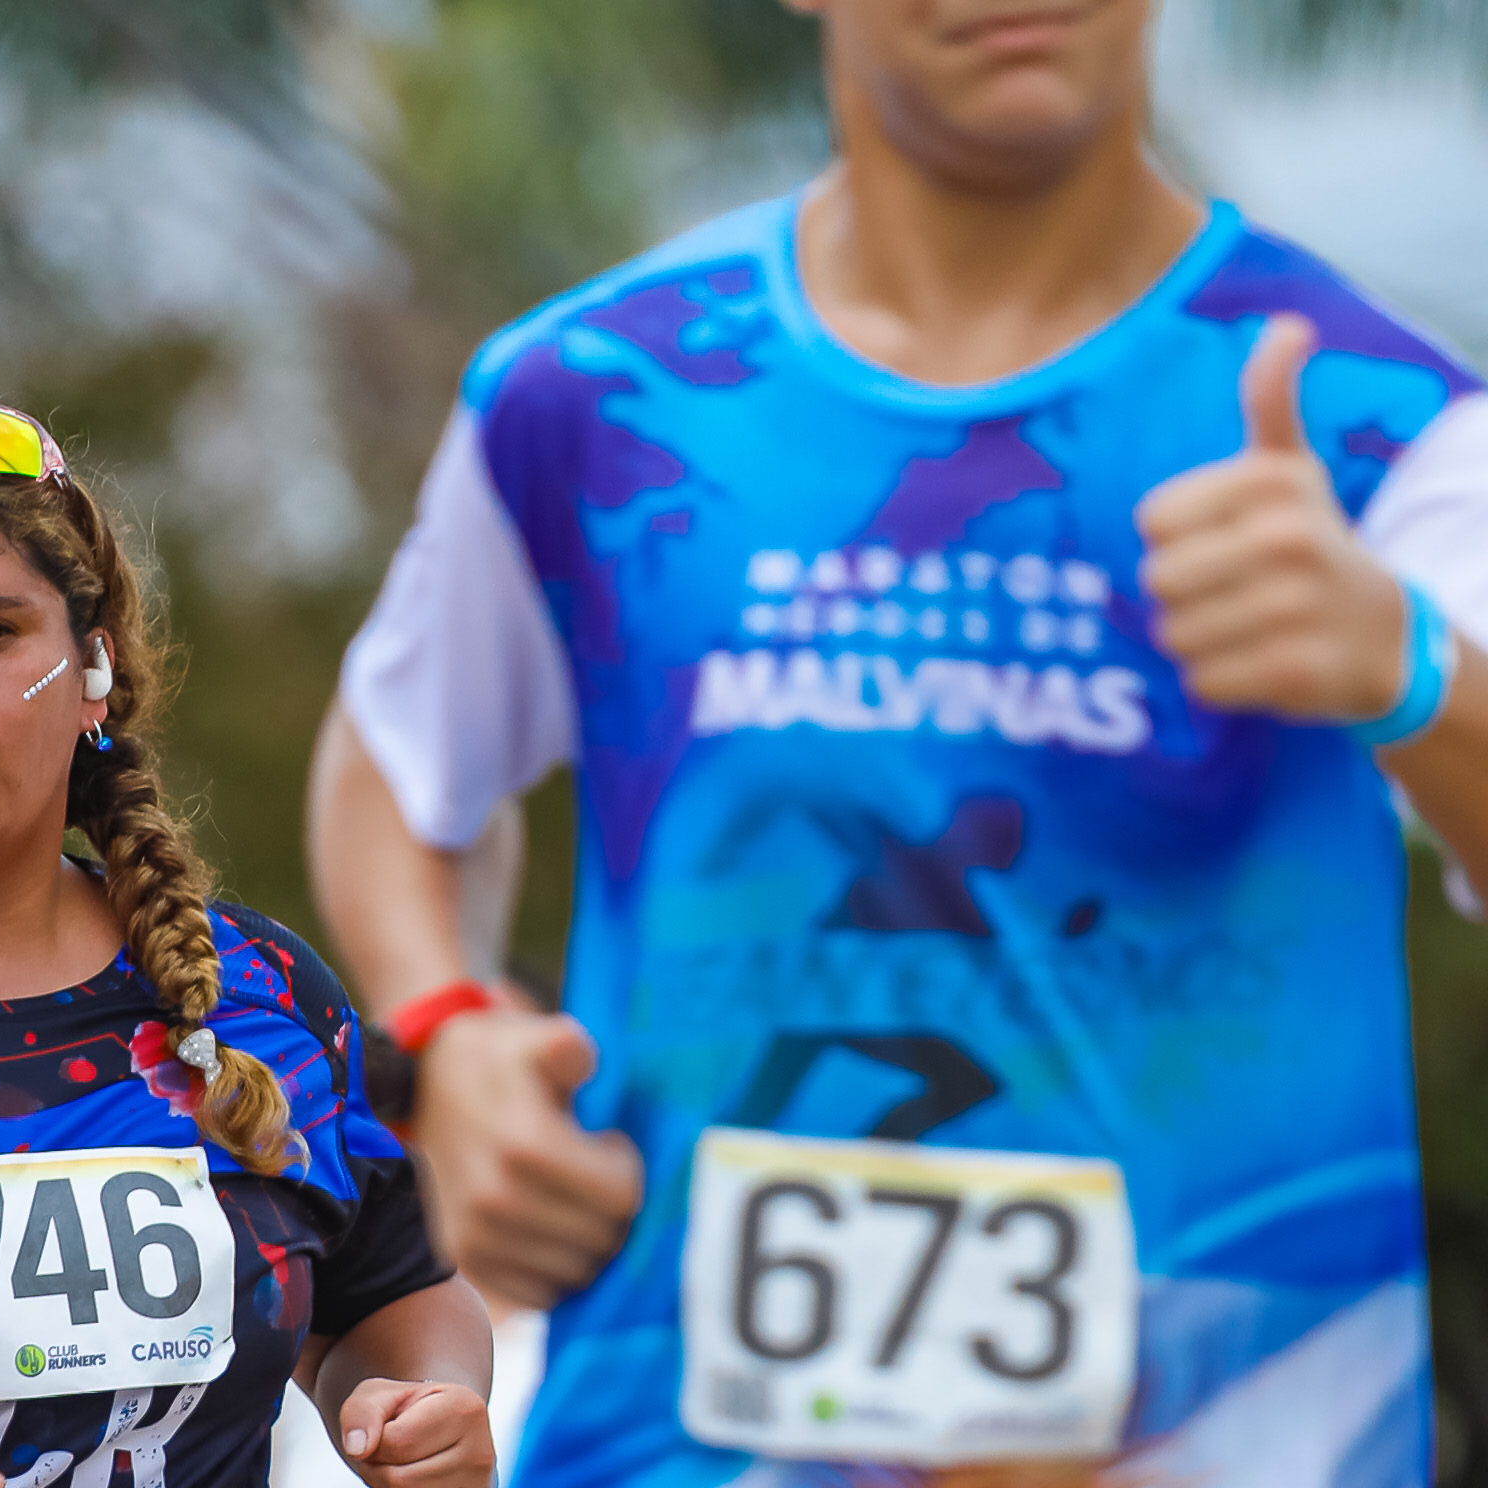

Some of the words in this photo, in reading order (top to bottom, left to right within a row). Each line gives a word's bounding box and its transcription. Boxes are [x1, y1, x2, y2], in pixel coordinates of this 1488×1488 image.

[691, 649, 1151, 751] MALVINAS
[733, 1179, 1083, 1382] 673
[48, 1344, 79, 1358] CLUB
[131, 1338, 212, 1362] CARUSO
